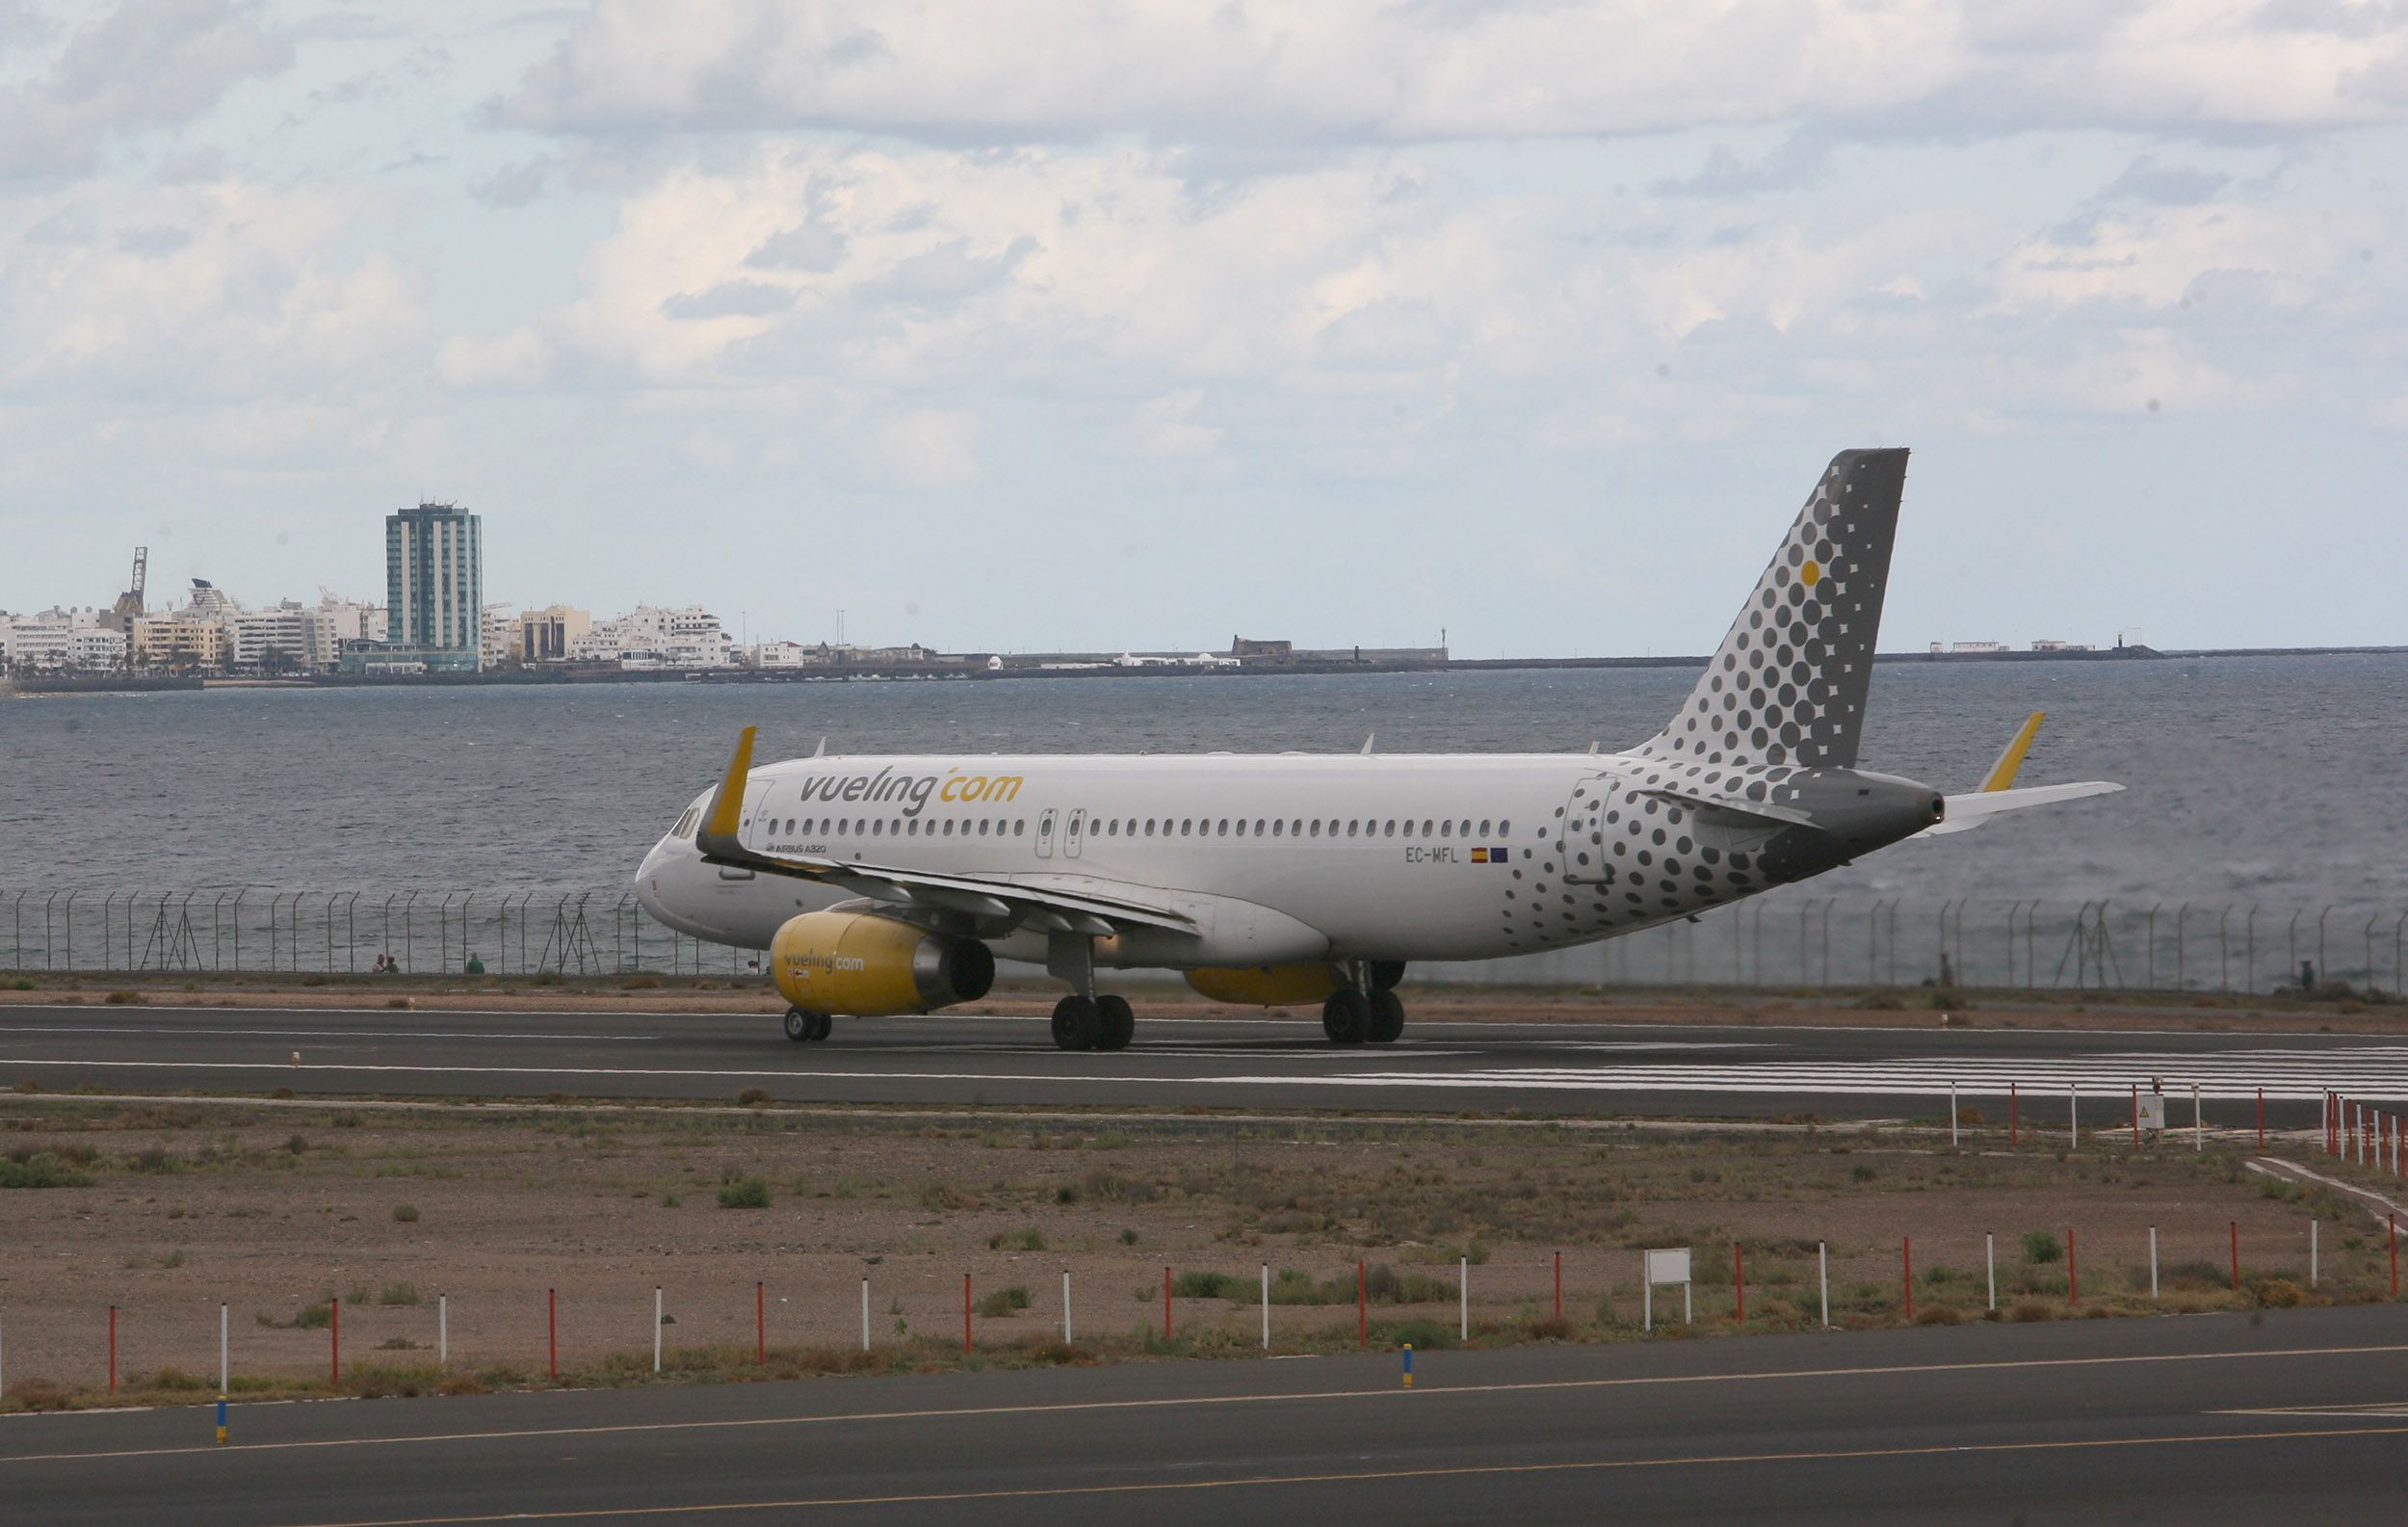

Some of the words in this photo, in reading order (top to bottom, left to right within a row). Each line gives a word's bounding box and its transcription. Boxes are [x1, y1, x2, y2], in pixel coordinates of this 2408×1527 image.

[775, 844, 803, 854] AIRBUS
[804, 844, 826, 854] A320
[1405, 847, 1459, 863] EC-MFL
